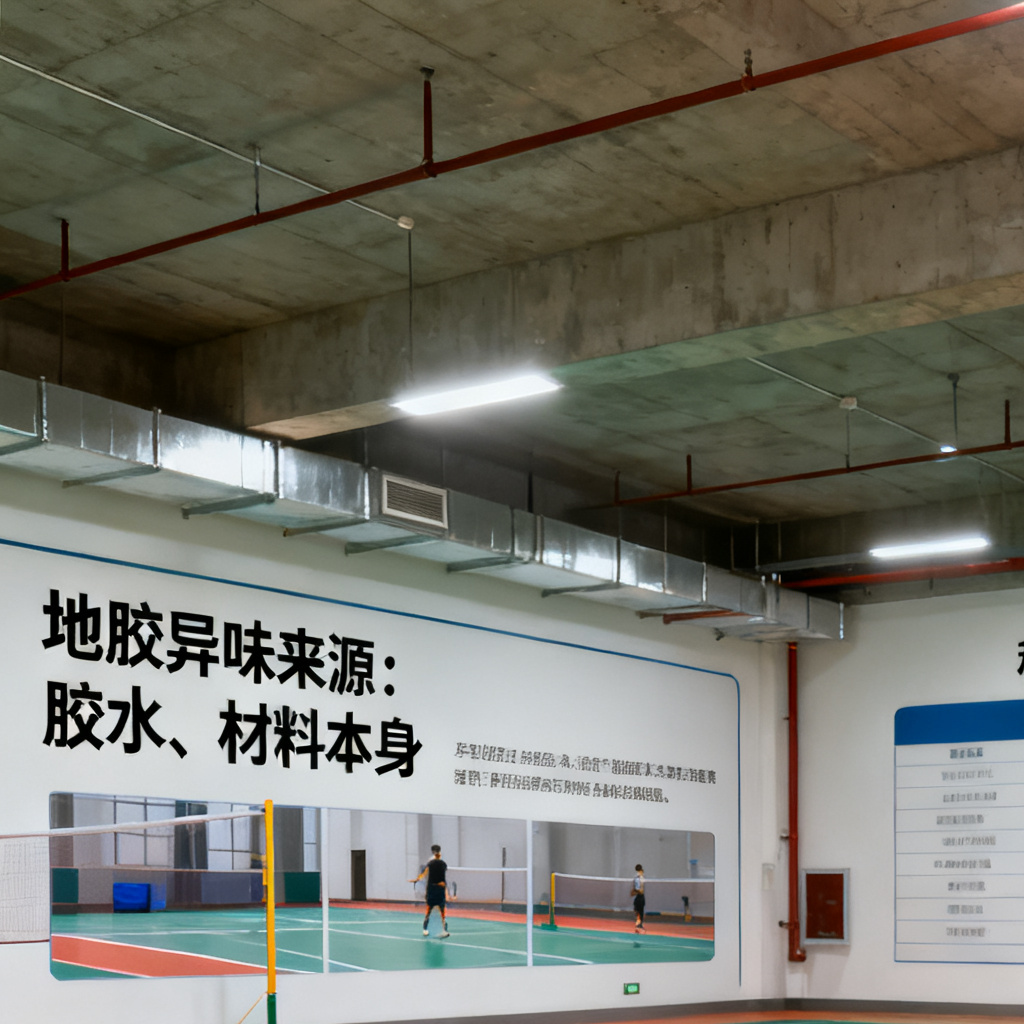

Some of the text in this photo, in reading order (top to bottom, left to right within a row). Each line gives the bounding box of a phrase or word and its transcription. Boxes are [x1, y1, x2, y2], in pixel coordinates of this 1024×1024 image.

[43, 681, 423, 778] 胶水、材料本身
